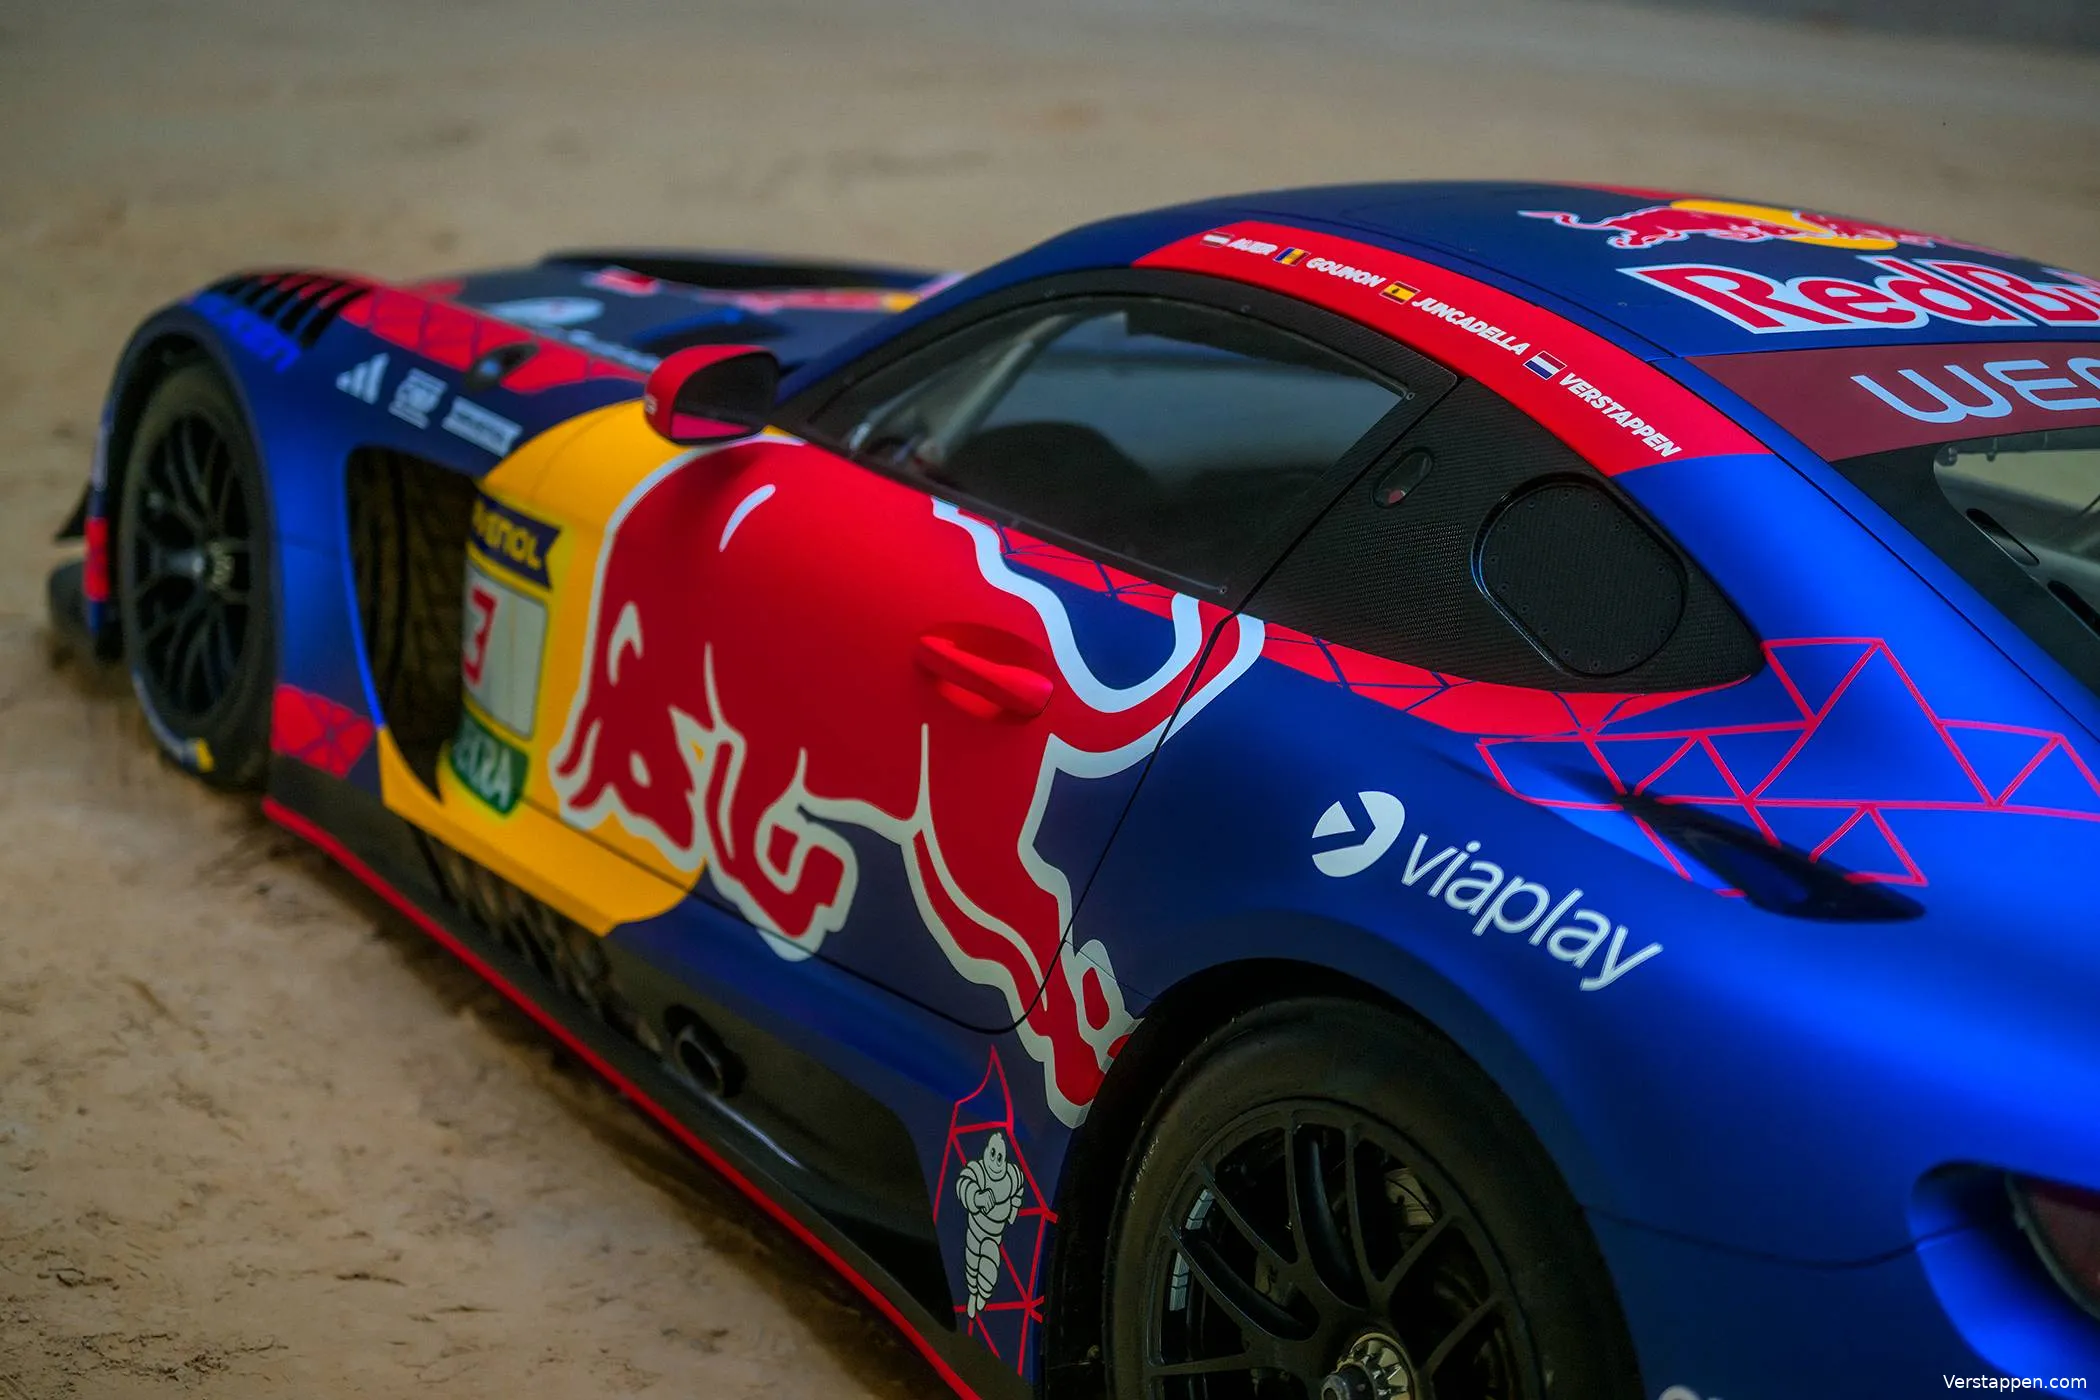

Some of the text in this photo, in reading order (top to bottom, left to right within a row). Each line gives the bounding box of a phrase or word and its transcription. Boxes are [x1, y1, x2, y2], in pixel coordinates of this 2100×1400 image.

[1306, 257, 1386, 287] GOUNON
[1412, 297, 1531, 356] JUNCADELLA
[1559, 373, 1682, 457] VERSTAPPEN
[1401, 833, 1664, 992] viaplay
